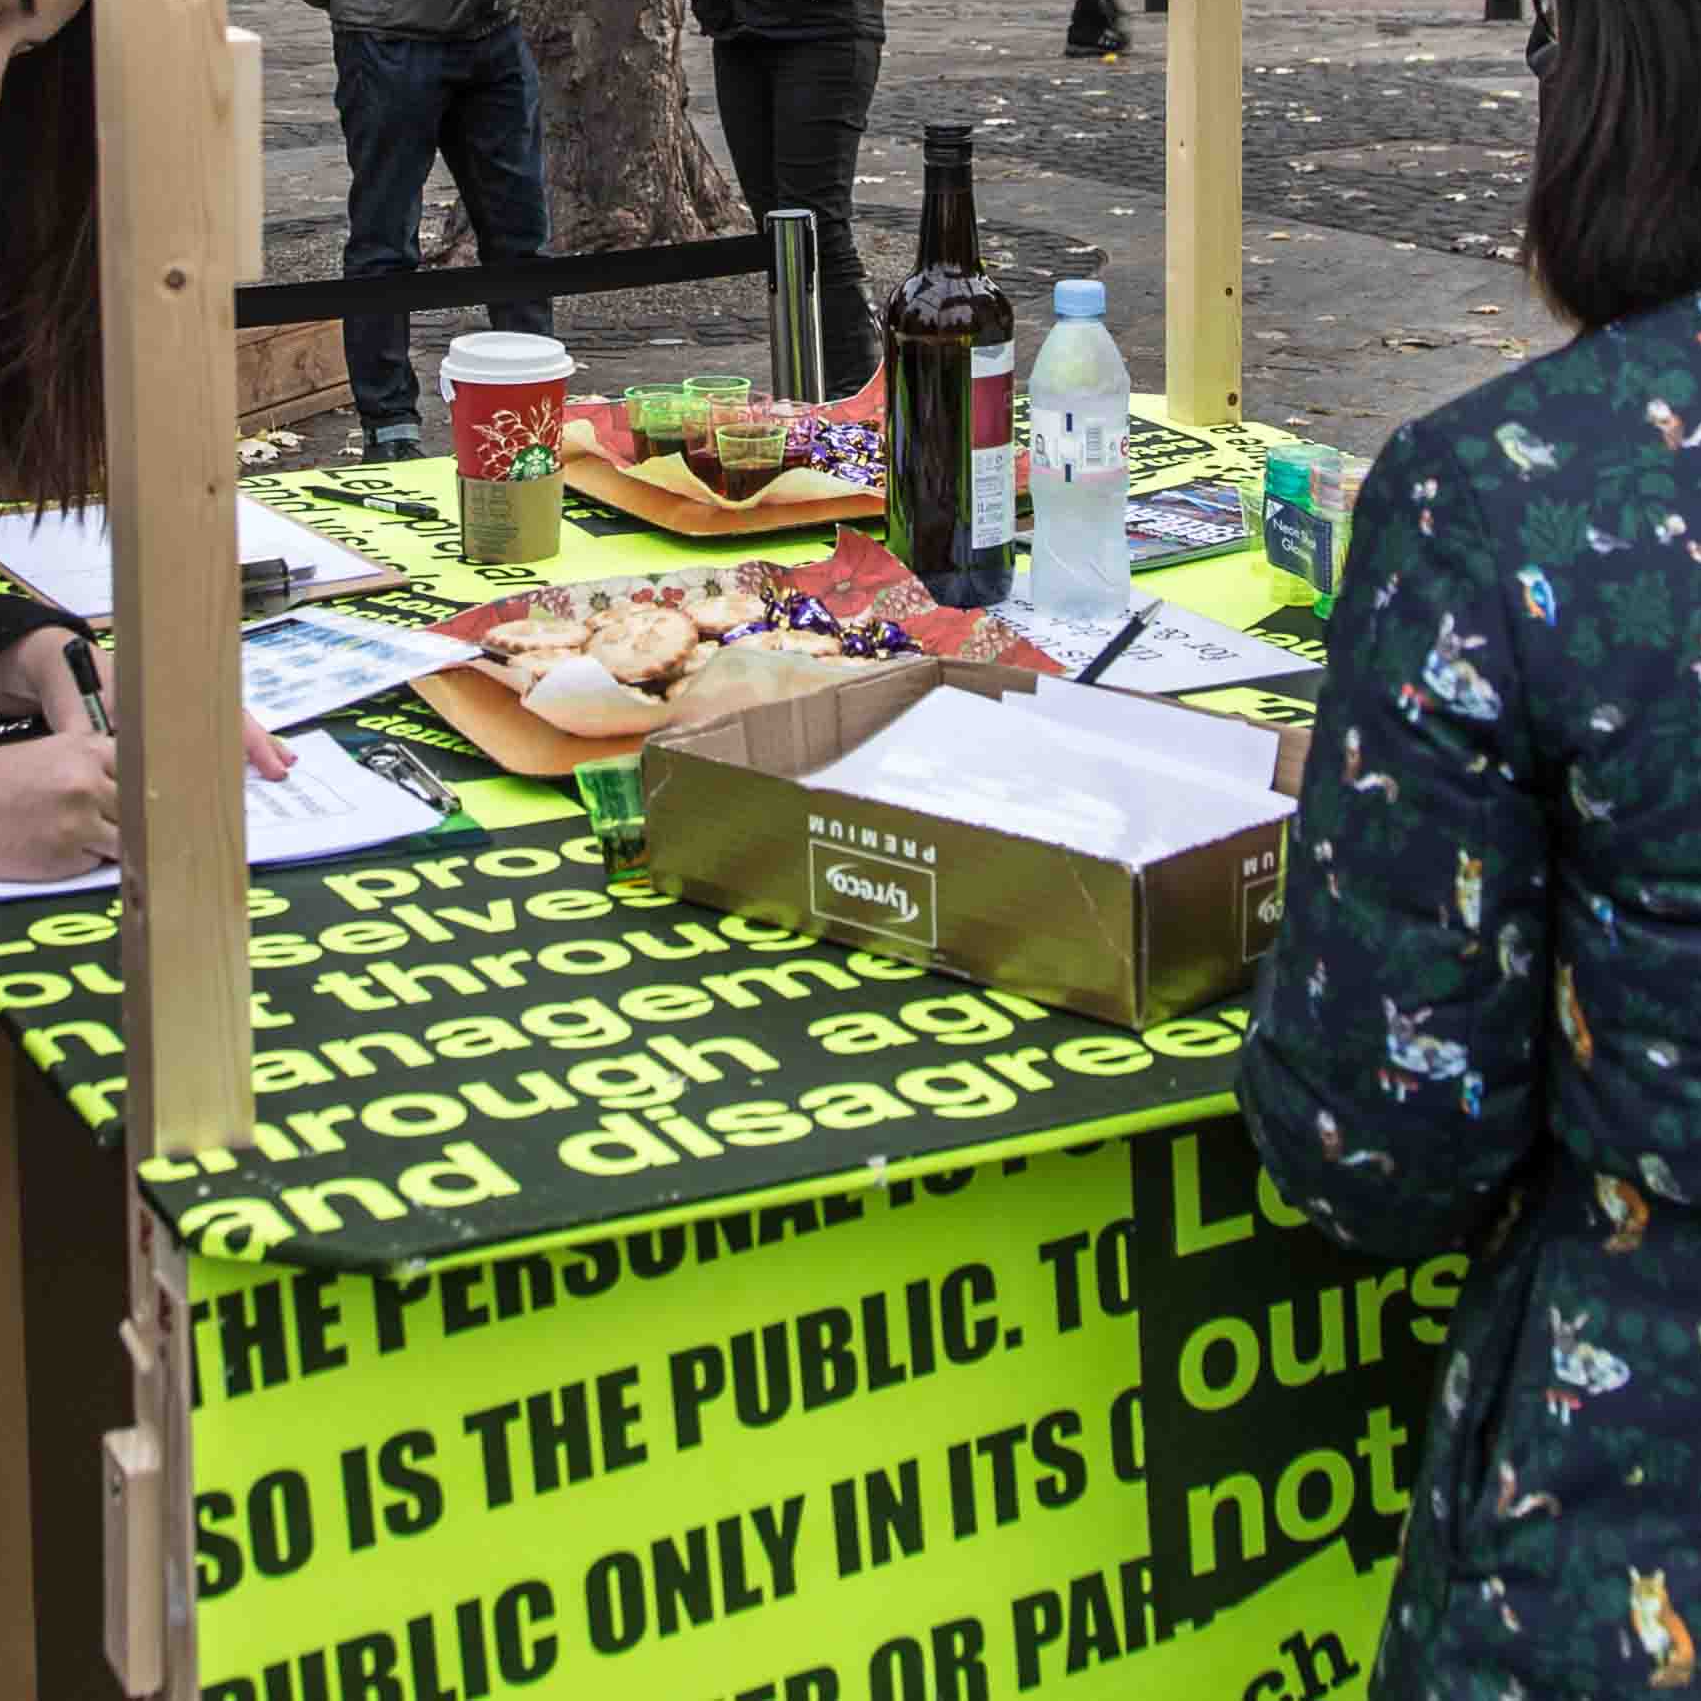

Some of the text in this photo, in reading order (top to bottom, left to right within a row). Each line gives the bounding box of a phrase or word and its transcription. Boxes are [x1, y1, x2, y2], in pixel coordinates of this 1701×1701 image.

[808, 814, 938, 865] PREMIUM
[830, 869, 912, 919] Lyreco
[179, 1140, 522, 1260] and
[195, 1468, 311, 1600] SO
[341, 1426, 446, 1552] IS
[464, 1365, 648, 1510] THE
[668, 1261, 1022, 1452] PUBLIC.
[1188, 1406, 1411, 1577] not
[584, 1496, 807, 1657] ONLY
[831, 1458, 926, 1579] IN
[948, 1408, 1090, 1562] ITS
